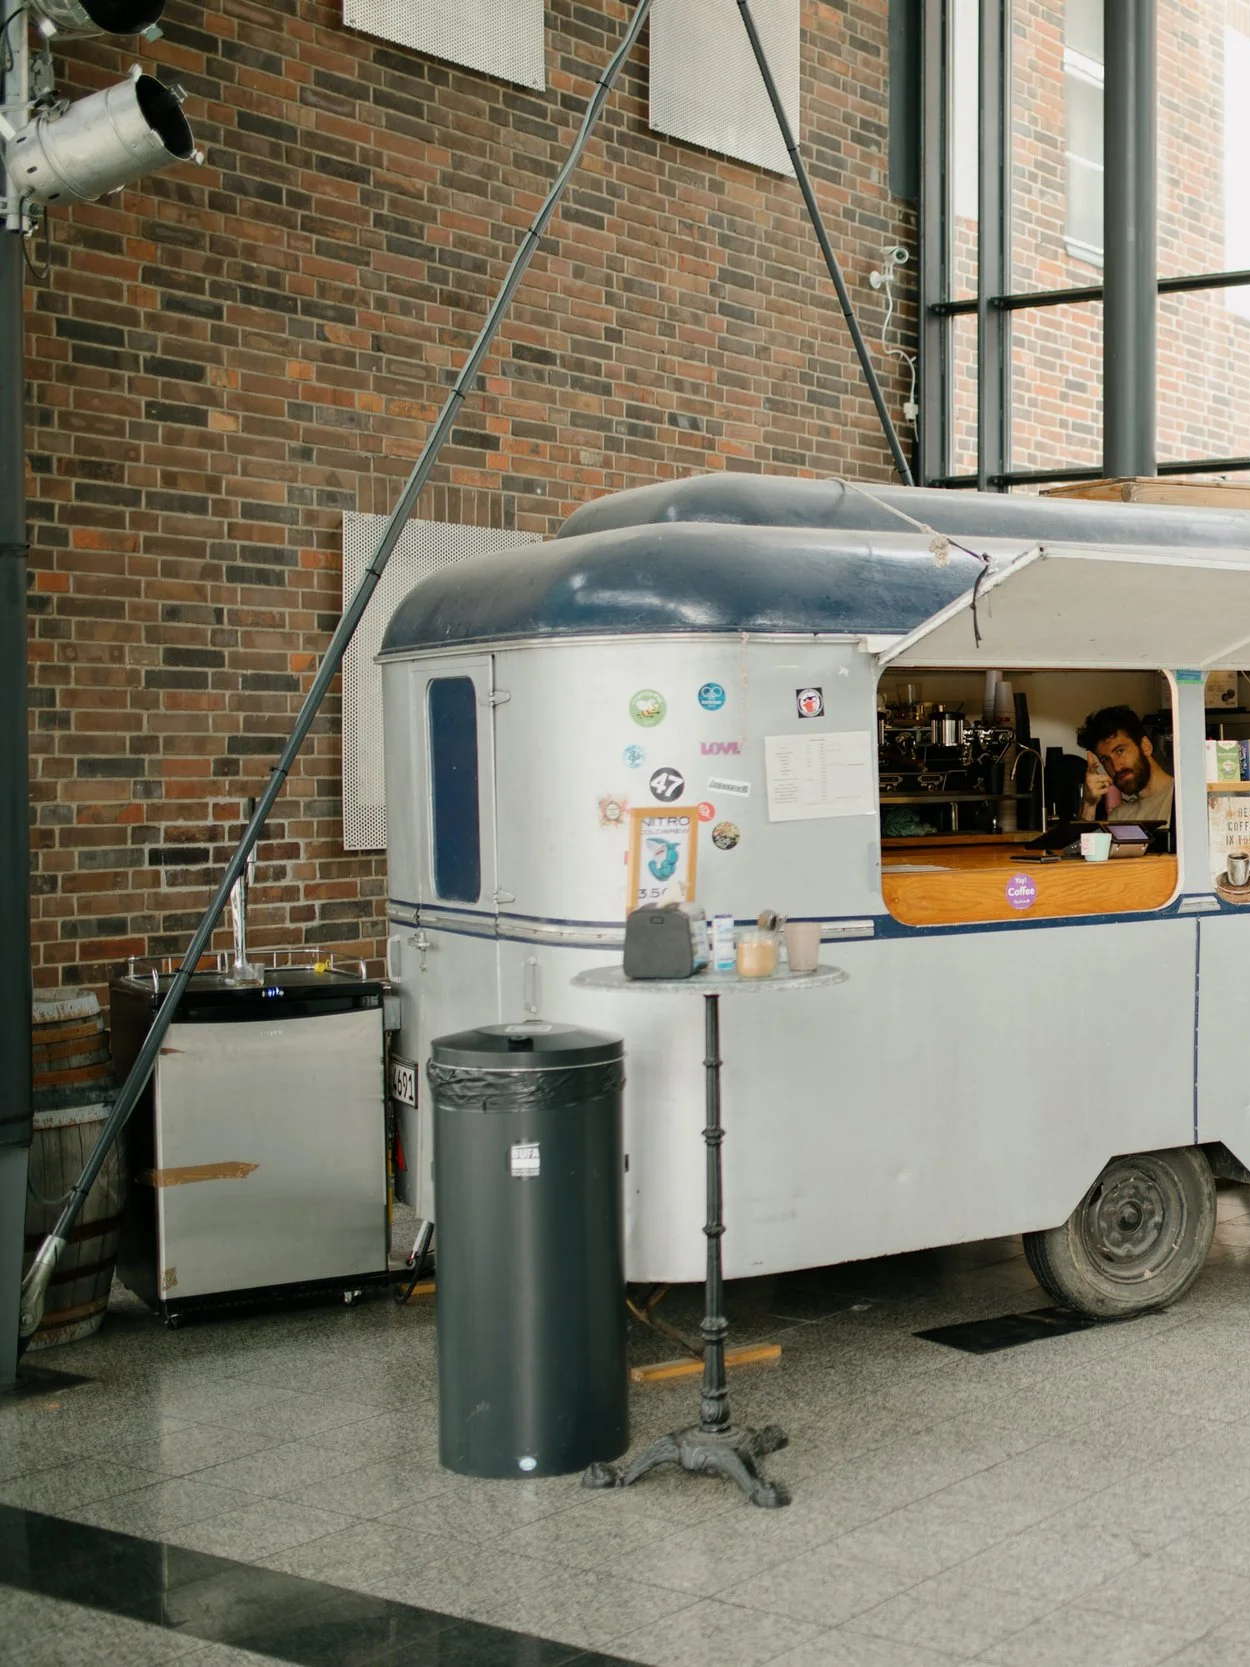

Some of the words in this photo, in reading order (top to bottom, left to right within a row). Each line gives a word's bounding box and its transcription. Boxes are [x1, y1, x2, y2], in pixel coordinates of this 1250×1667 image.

[700, 741, 741, 756] LOVE
[650, 772, 684, 797] 47
[641, 815, 690, 826] NITRO
[1007, 886, 1035, 897] Coffee
